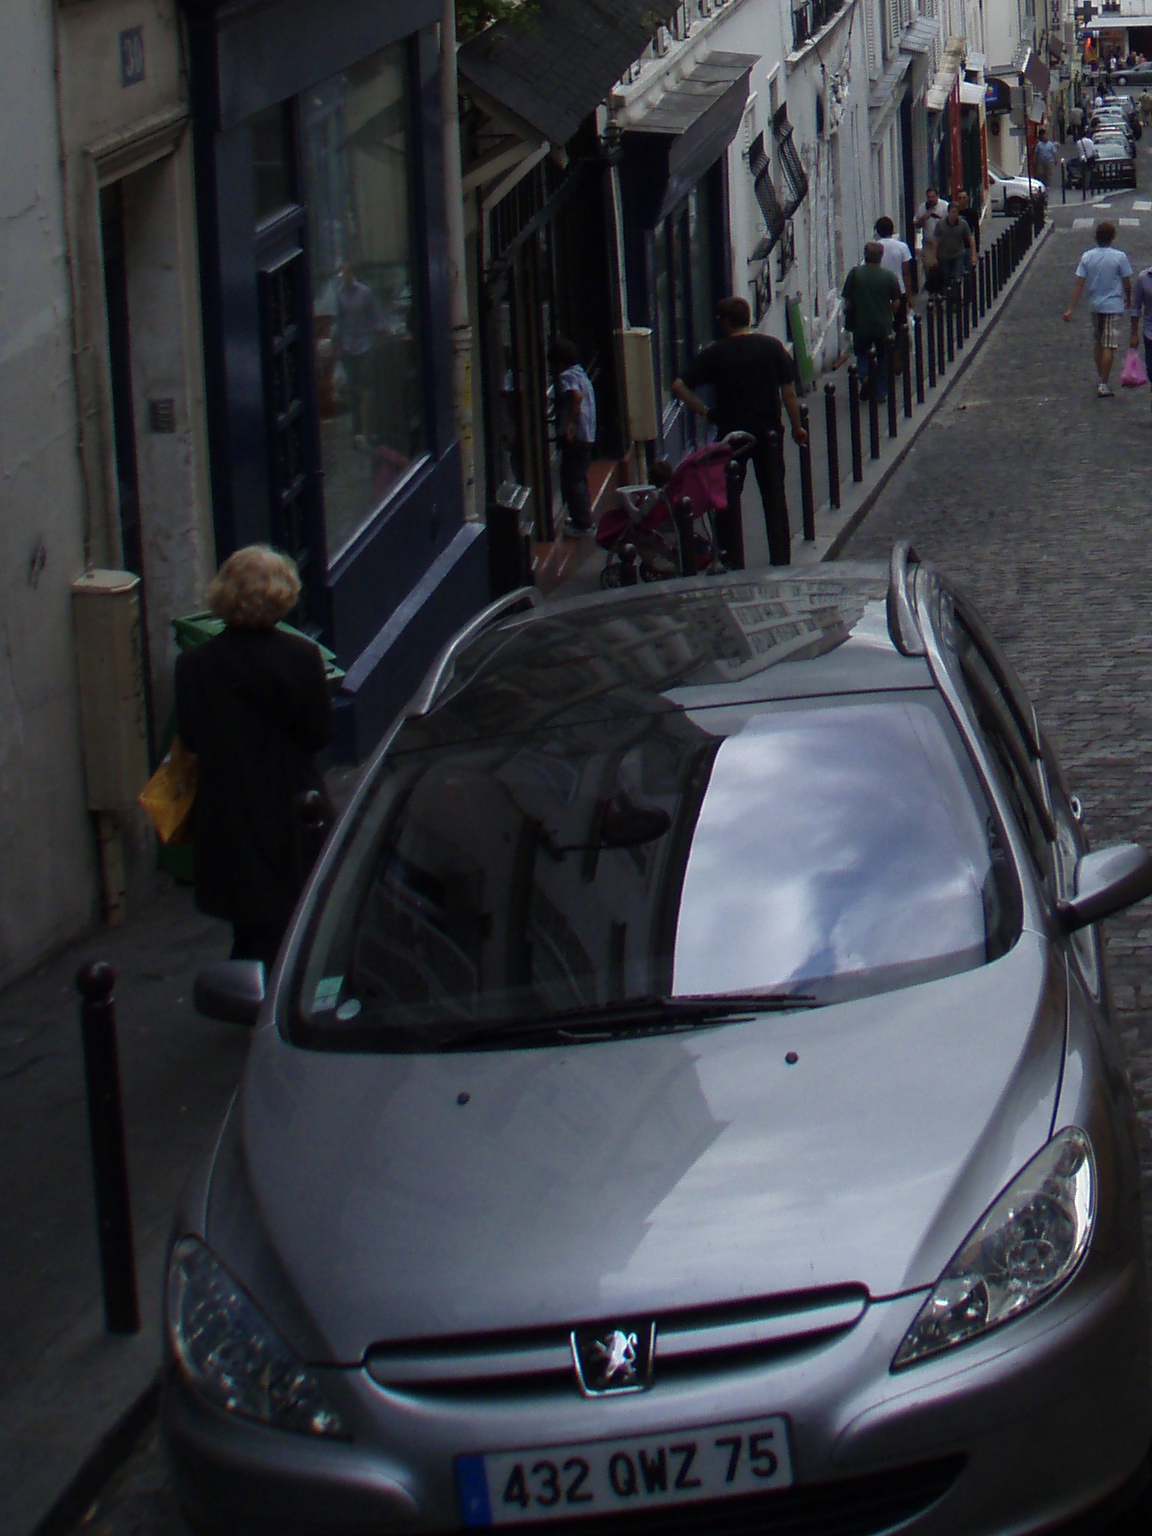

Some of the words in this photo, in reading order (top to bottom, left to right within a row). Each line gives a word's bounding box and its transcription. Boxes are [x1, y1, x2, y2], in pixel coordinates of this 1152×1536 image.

[502, 1457, 593, 1508] 432
[608, 1442, 702, 1497] QWZ
[714, 1431, 779, 1483] 75
